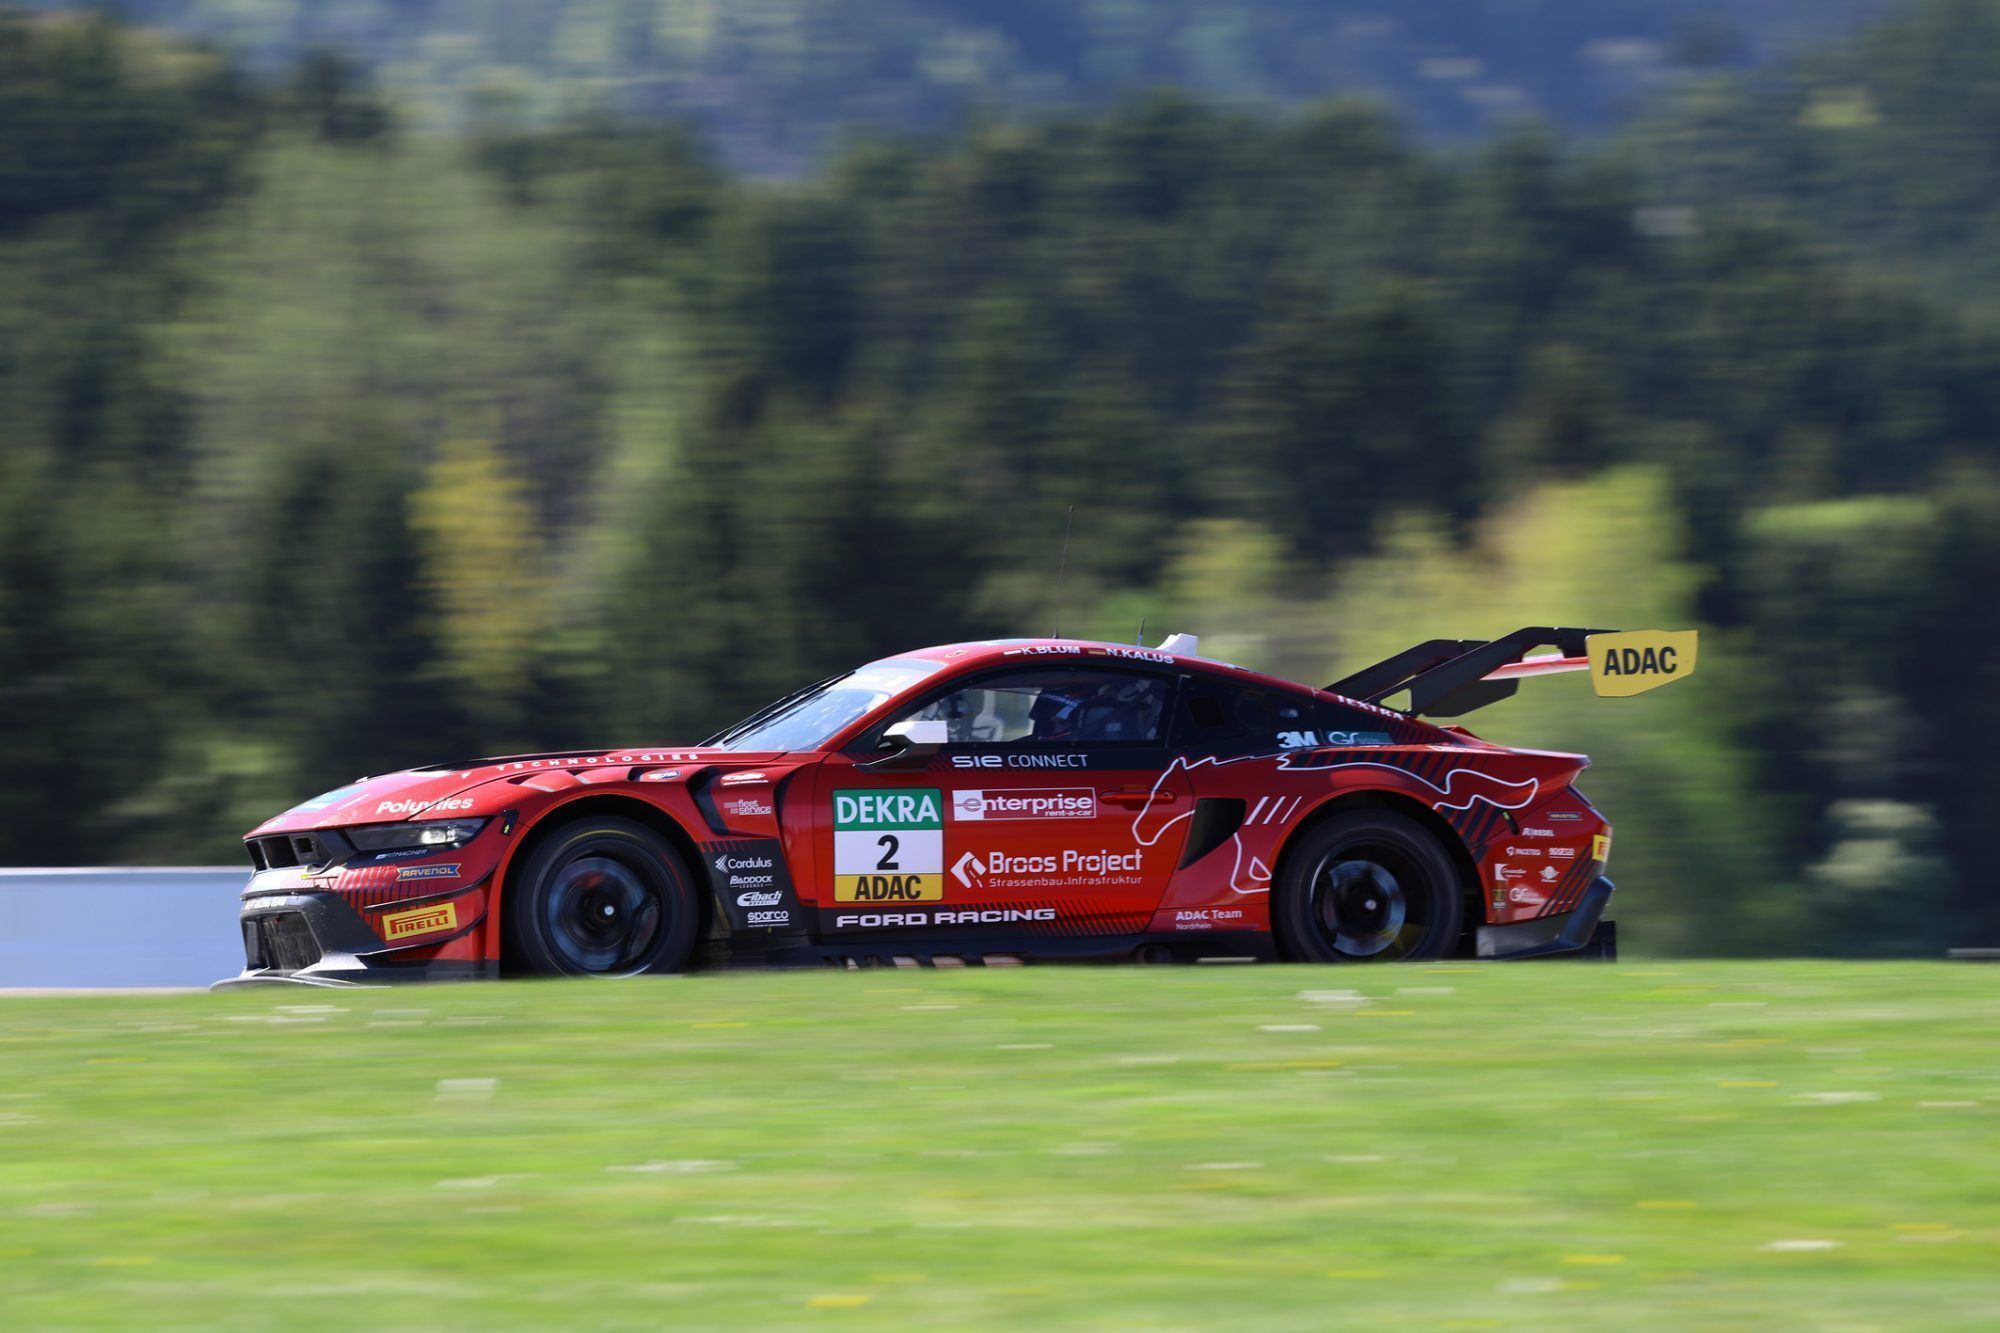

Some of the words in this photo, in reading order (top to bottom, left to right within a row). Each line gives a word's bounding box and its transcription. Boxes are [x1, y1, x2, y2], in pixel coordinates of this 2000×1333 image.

[1021, 646, 1080, 655] K.BLUM
[1106, 648, 1174, 664] N.KALUS
[1603, 646, 1677, 676] ADAC
[1276, 731, 1319, 748] 3M
[497, 753, 698, 771] TECHNOLOGIES
[1007, 754, 1088, 767] CONNECT
[836, 795, 939, 823] DEKRA
[963, 794, 1092, 814] enterprise
[876, 834, 899, 870] 2
[728, 857, 772, 869] Cordulus
[989, 852, 1057, 874] Broos
[1063, 849, 1142, 875] Project
[402, 867, 453, 877] RAVENOL
[854, 875, 921, 900] ADAC
[737, 890, 783, 906] Eibach
[389, 909, 449, 934] PIRELLI
[747, 910, 788, 923] sparco
[836, 913, 927, 927] FORD
[934, 908, 1055, 924] RACING
[1176, 910, 1209, 920] ADAC
[1211, 910, 1242, 919] Team
